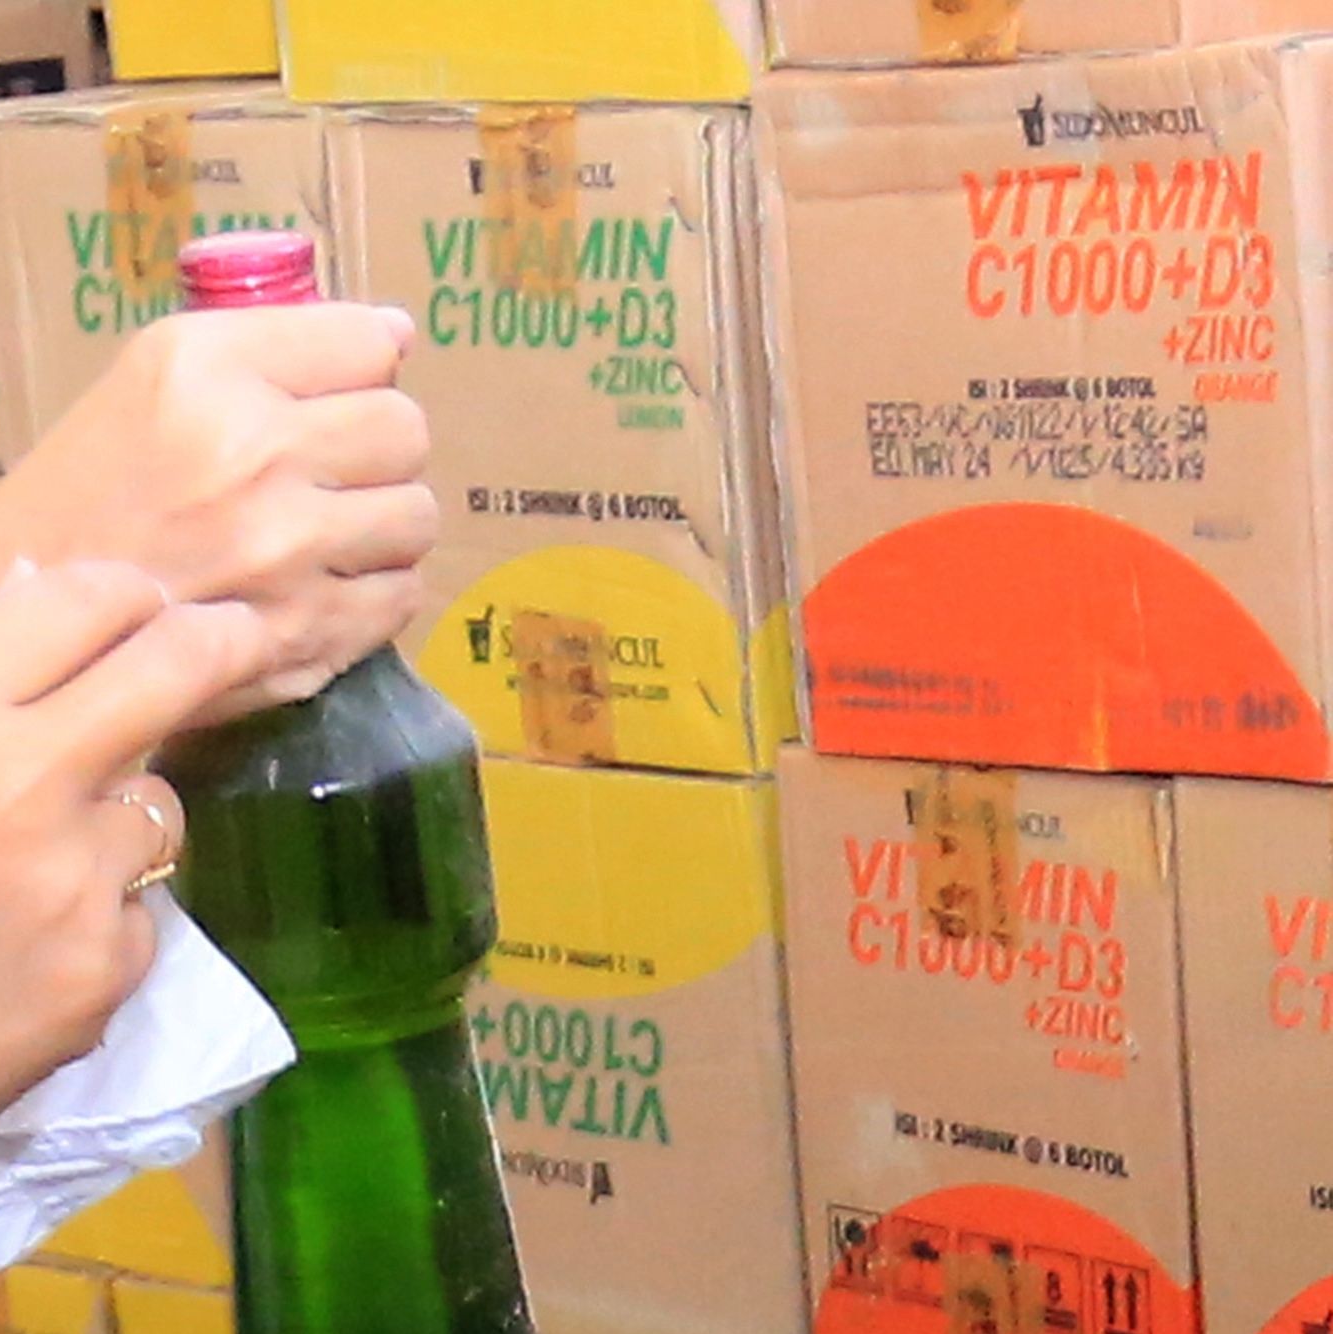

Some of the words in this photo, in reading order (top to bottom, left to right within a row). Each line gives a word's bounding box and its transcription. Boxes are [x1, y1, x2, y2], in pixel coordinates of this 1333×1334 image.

[960, 151, 1264, 239] VITAMIN
[965, 234, 1275, 319] C1000+D3
[428, 284, 677, 348] C1000+D3
[1163, 315, 1277, 365] +ZINC
[590, 356, 683, 395] +ZINC
[1025, 995, 1126, 1044] +ZINC
[934, 1118, 945, 1143] 2
[949, 1122, 1018, 1156] SHRINK
[1064, 1145, 1130, 1178] BOTOL
